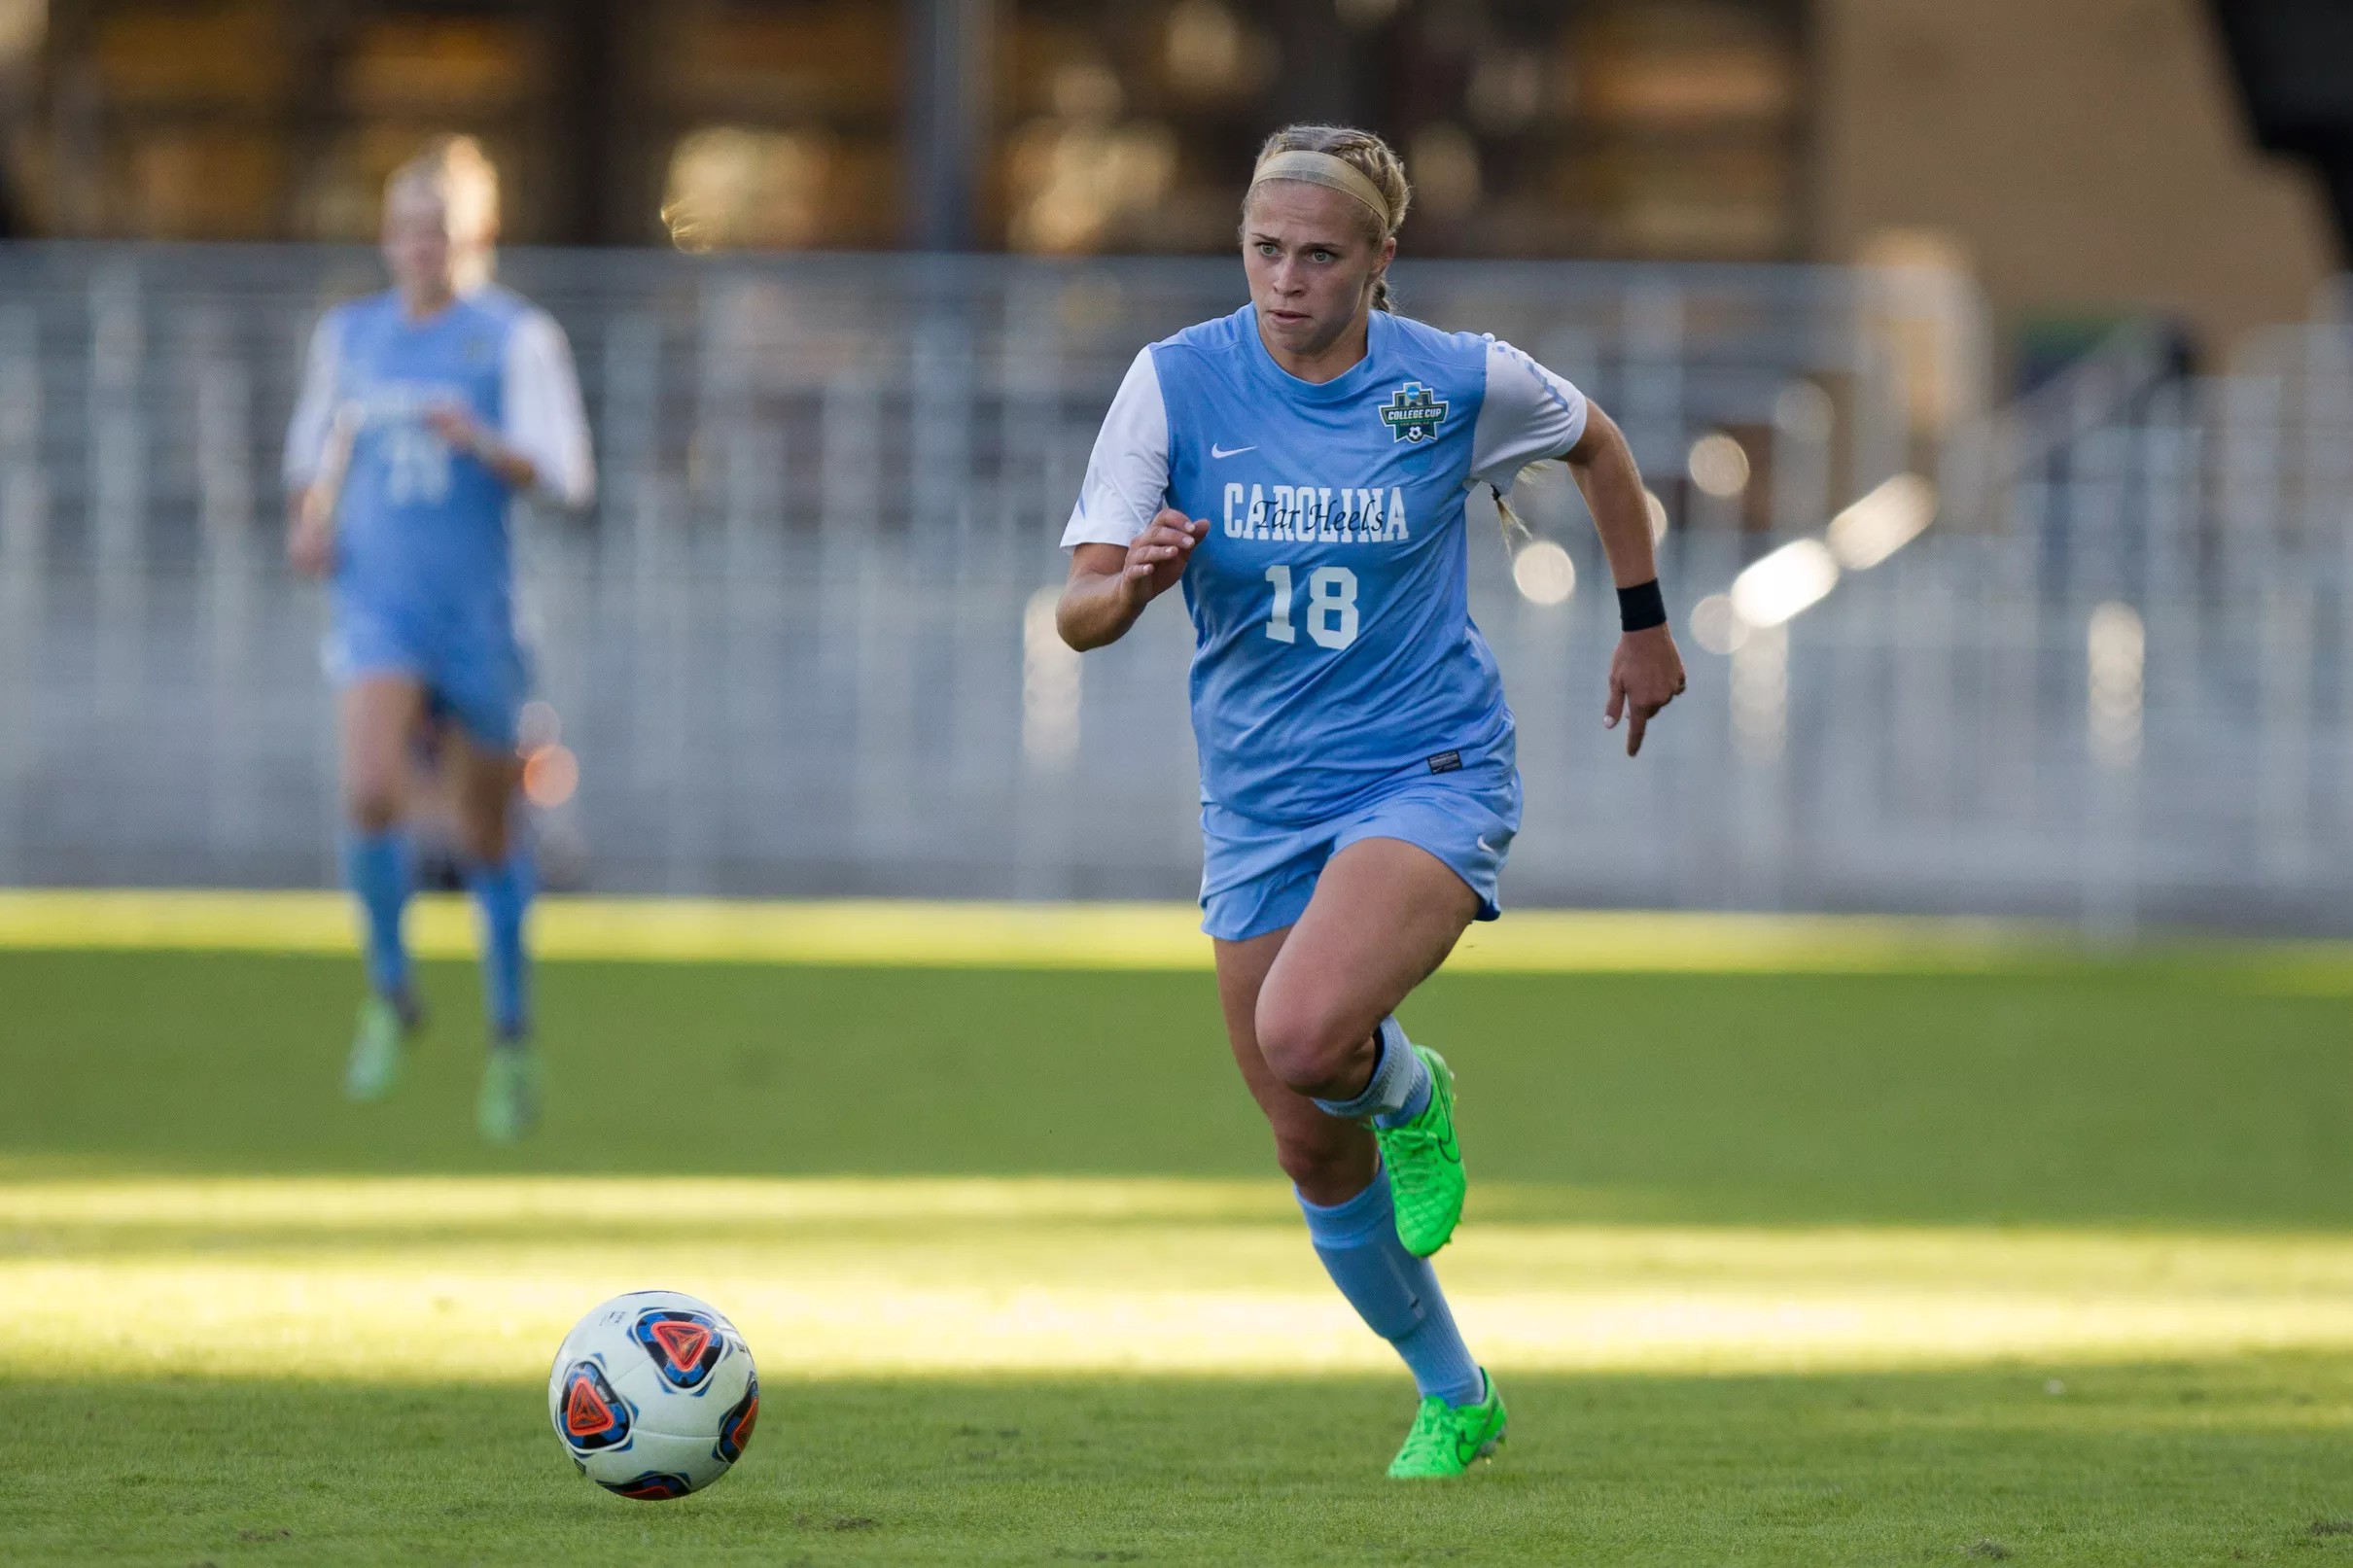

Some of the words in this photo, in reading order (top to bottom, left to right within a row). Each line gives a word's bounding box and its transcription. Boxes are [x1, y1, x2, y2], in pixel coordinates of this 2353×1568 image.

[1387, 410, 1423, 421] COLLEGE
[1424, 408, 1442, 418] CUP
[1223, 482, 1409, 543] CAROLINA
[1253, 499, 1301, 529] Tar
[1304, 499, 1386, 532] Heels
[1265, 565, 1359, 650] 18
